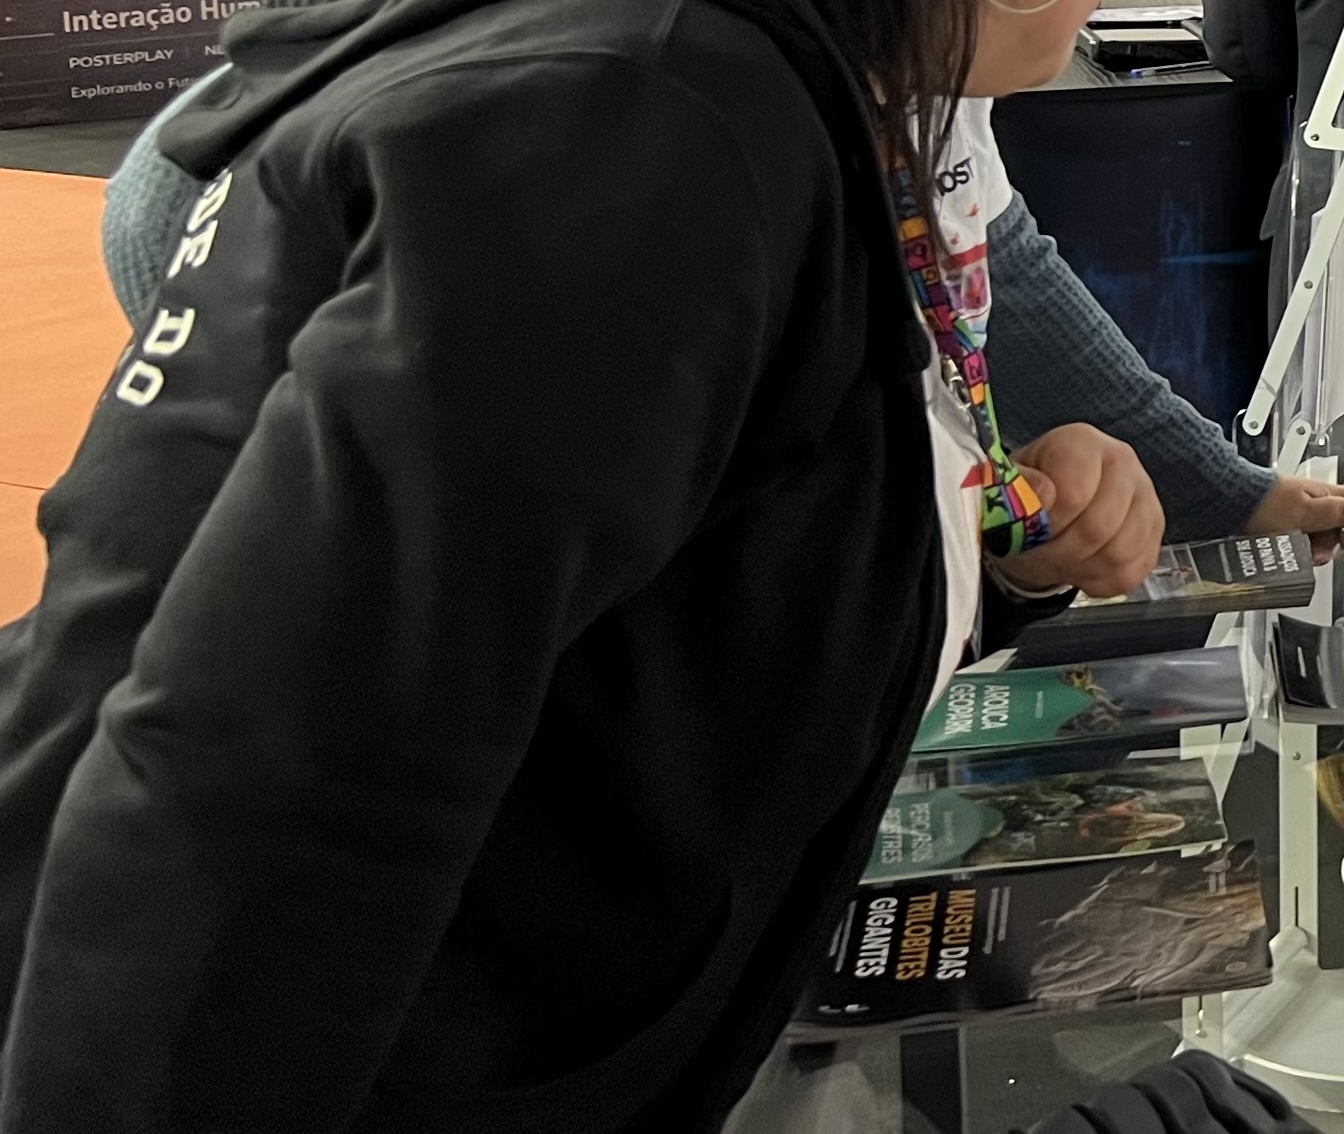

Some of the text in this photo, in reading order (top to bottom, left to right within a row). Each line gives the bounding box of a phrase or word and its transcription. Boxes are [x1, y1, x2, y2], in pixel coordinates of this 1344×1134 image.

[63, 1, 193, 32] Interação
[69, 49, 175, 69] POSTERPLAY
[71, 80, 153, 99] Explorando
[155, 81, 165, 90] o
[116, 306, 196, 408] DO
[944, 683, 977, 735] GEOPARK
[980, 684, 1010, 730] AROUCA
[854, 897, 899, 978] GIGANTES
[895, 891, 939, 981] TRILOBITES
[936, 889, 977, 980] MUSEU DAS
